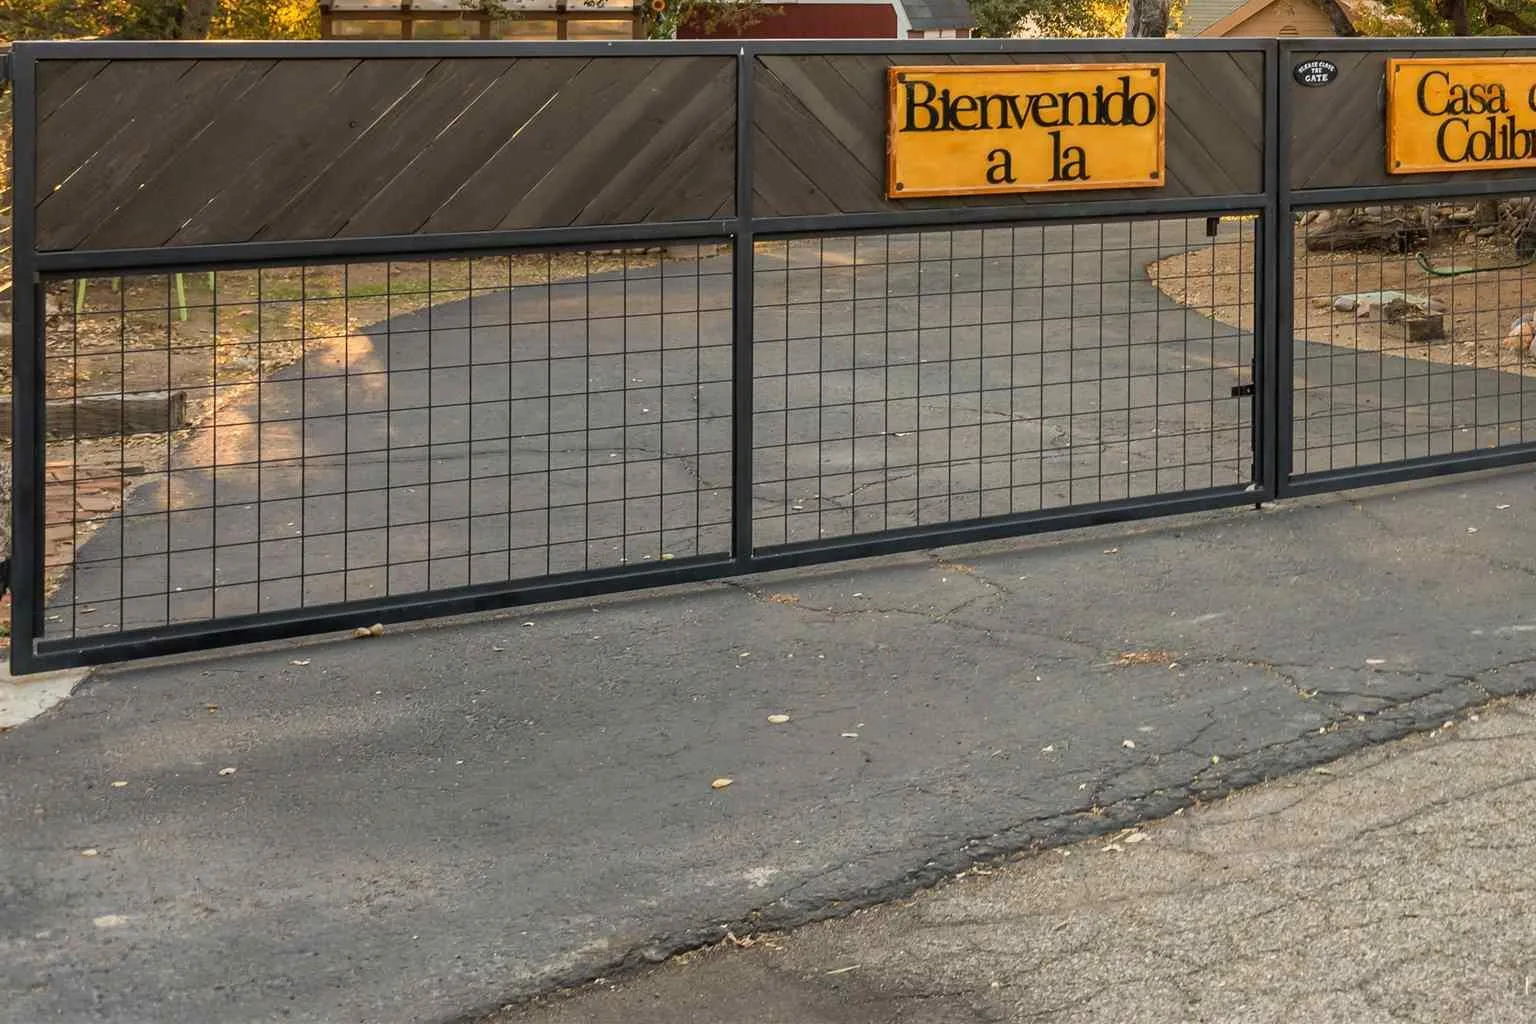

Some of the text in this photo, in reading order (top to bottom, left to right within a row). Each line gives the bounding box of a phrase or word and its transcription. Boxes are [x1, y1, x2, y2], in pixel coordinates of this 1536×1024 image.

[1304, 74, 1329, 82] GATE
[1417, 70, 1508, 116] Casa
[900, 76, 1157, 132] Bienvenido
[986, 131, 1090, 185] a la
